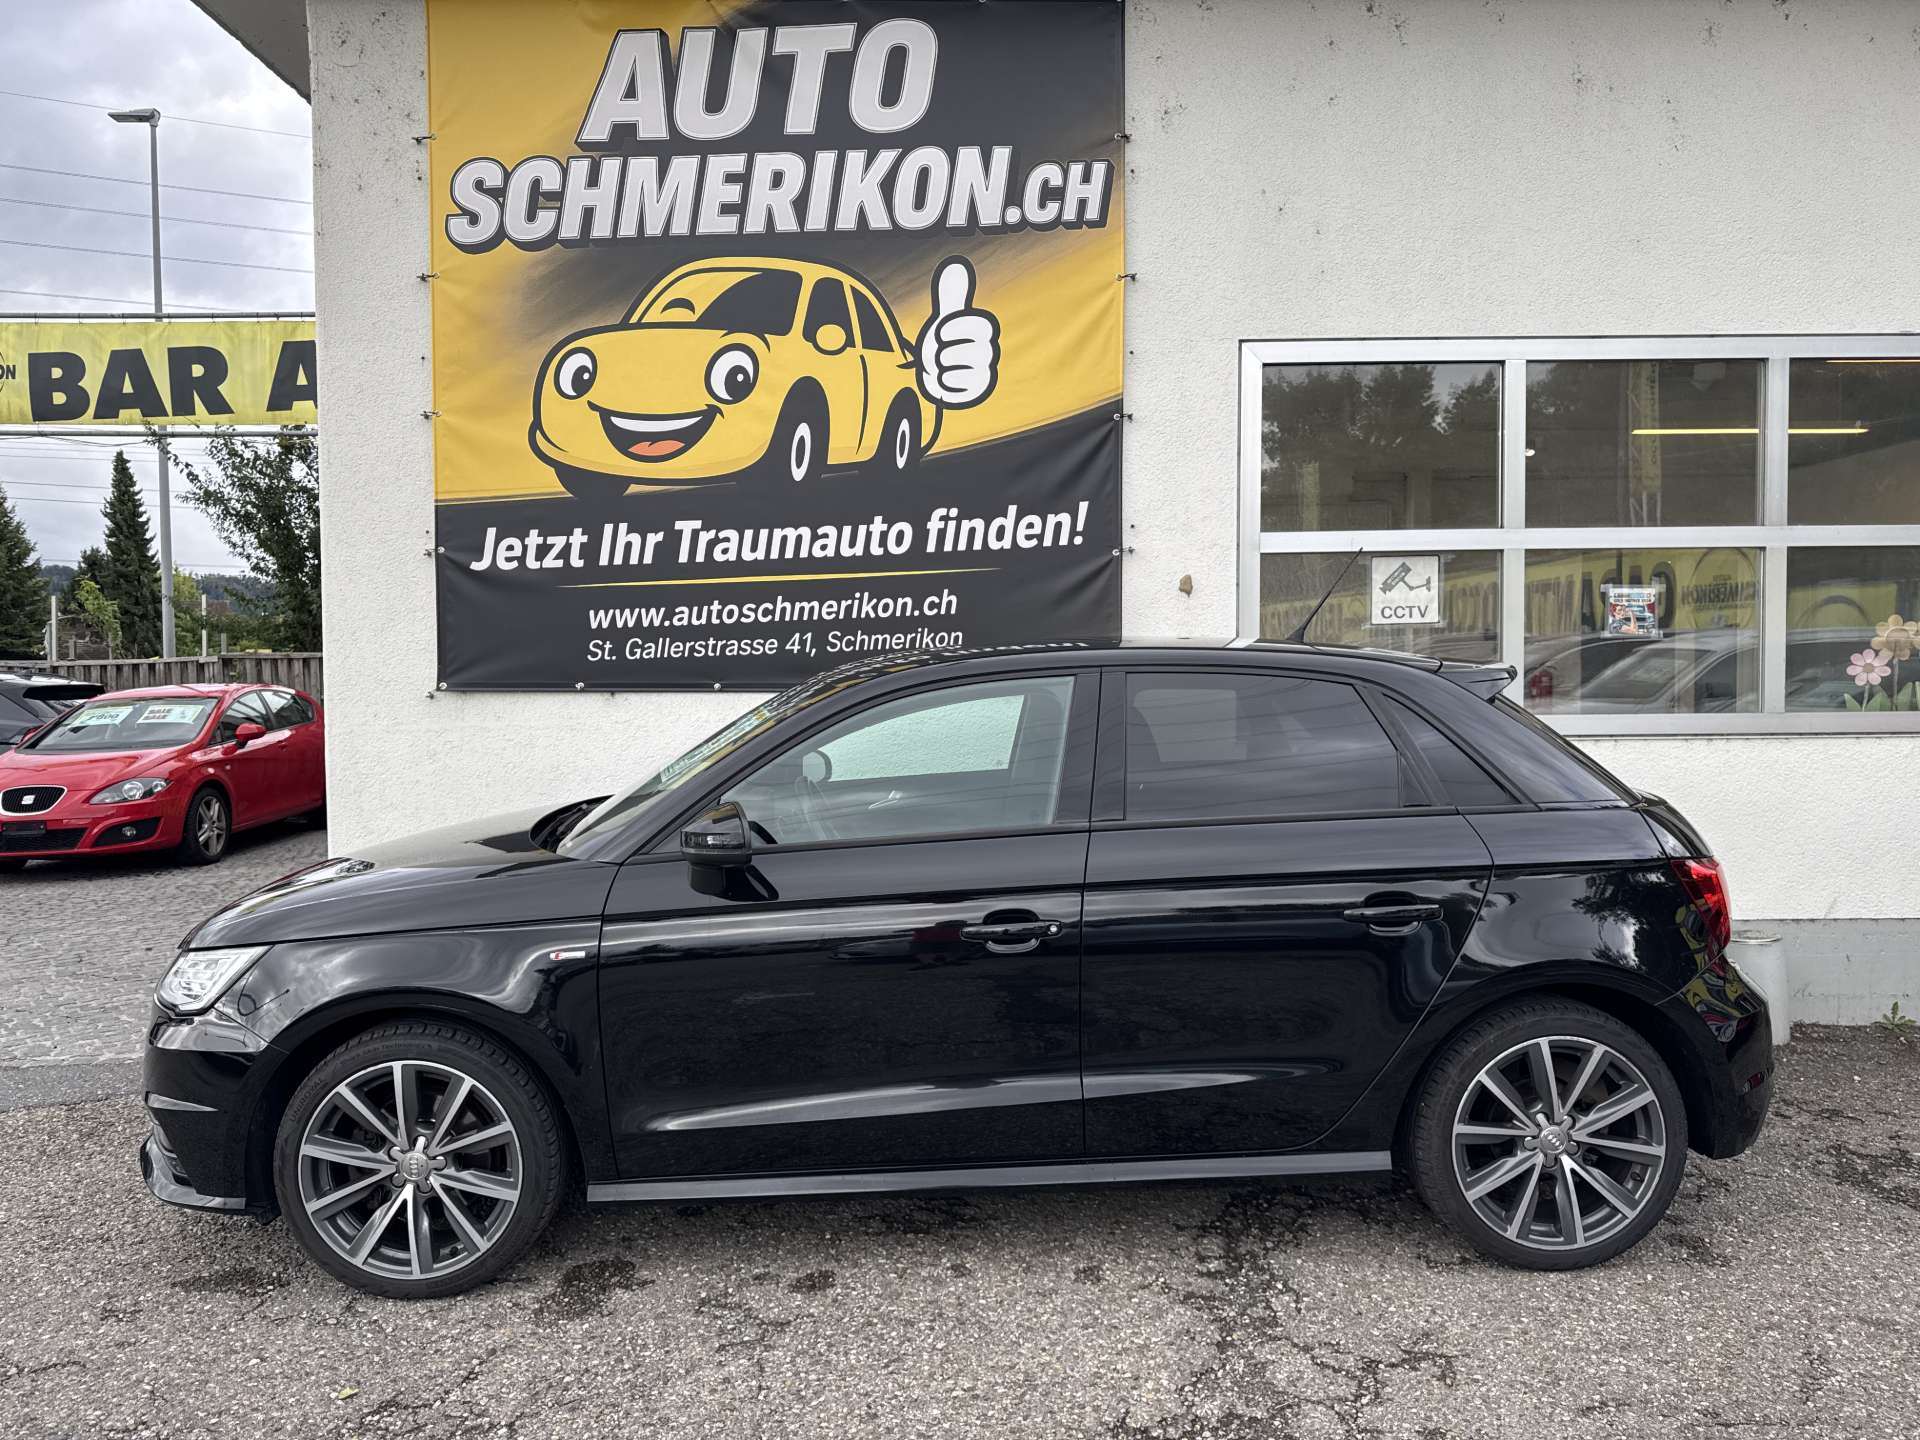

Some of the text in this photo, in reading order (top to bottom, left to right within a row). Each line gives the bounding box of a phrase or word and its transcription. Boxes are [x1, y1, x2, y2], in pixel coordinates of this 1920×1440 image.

[575, 17, 939, 142] AUTO
[446, 145, 1110, 247] SCHMERIKON.CH
[28, 346, 235, 422] BAR
[469, 500, 1090, 572] Jetzt Ihr Traumauto finden!
[586, 627, 963, 662] St. Gallerstrasse 41, Schmerikon
[588, 588, 958, 630] www.autoschmerikon.ch
[1380, 605, 1429, 619] CCTV
